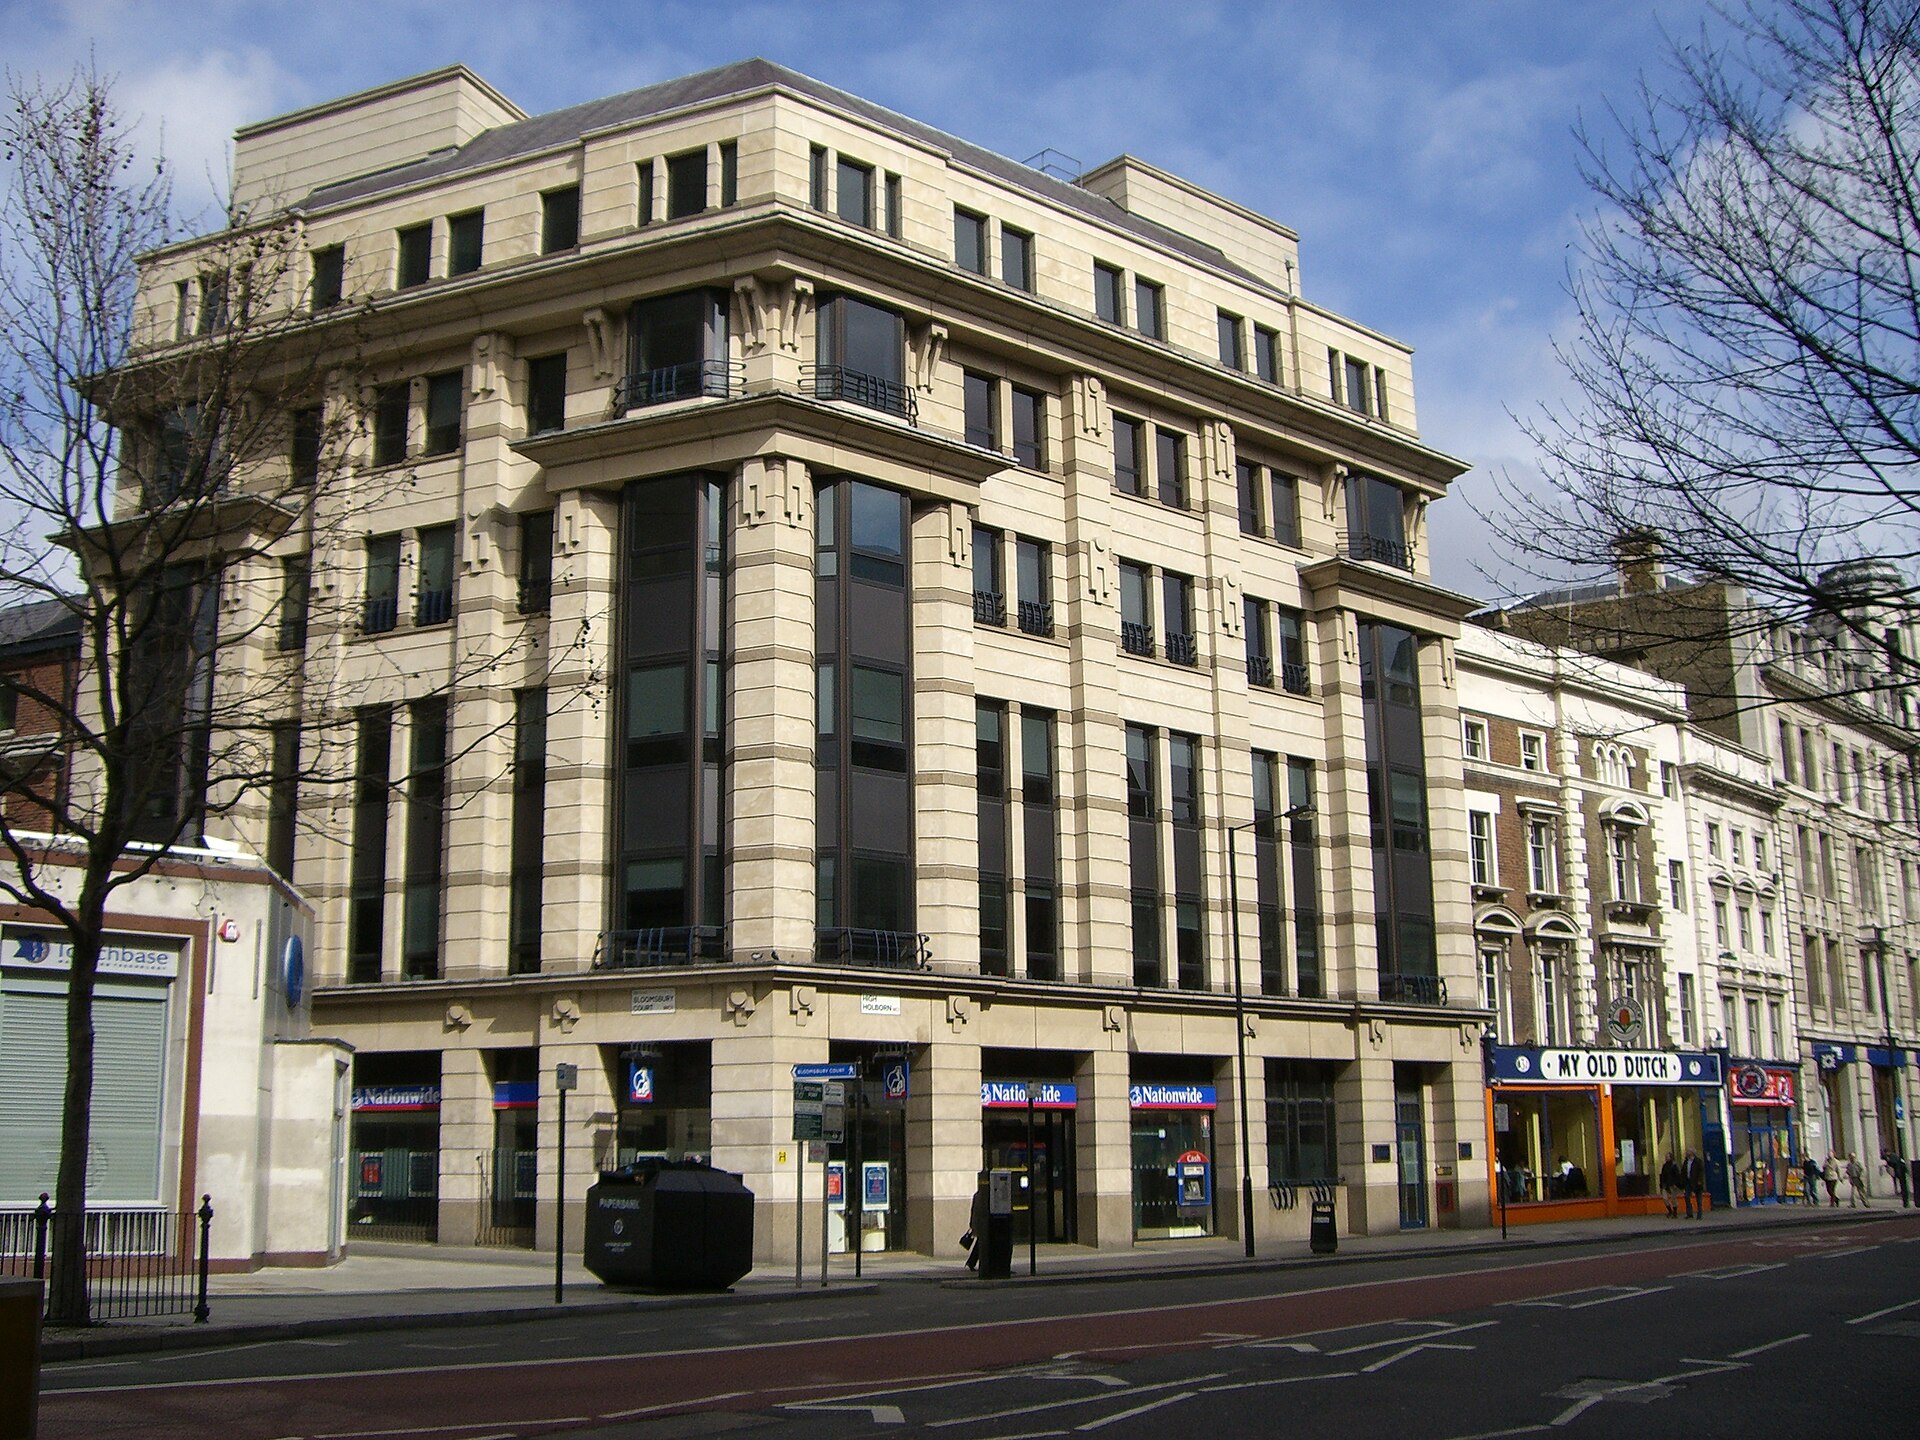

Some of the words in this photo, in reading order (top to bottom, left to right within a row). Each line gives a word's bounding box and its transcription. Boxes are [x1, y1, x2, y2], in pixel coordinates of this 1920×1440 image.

[633, 994, 674, 1004] BLOOMSBURY
[1558, 1053, 1580, 1077] MY
[1587, 1054, 1617, 1078] OLD
[1624, 1055, 1668, 1079] DUTCH
[364, 1086, 440, 1105] Nationwide
[992, 1083, 1061, 1102] Natioide
[1142, 1086, 1203, 1103] Nationwide
[1186, 1153, 1202, 1162] Cash
[599, 1198, 640, 1209] PAPERBANK
